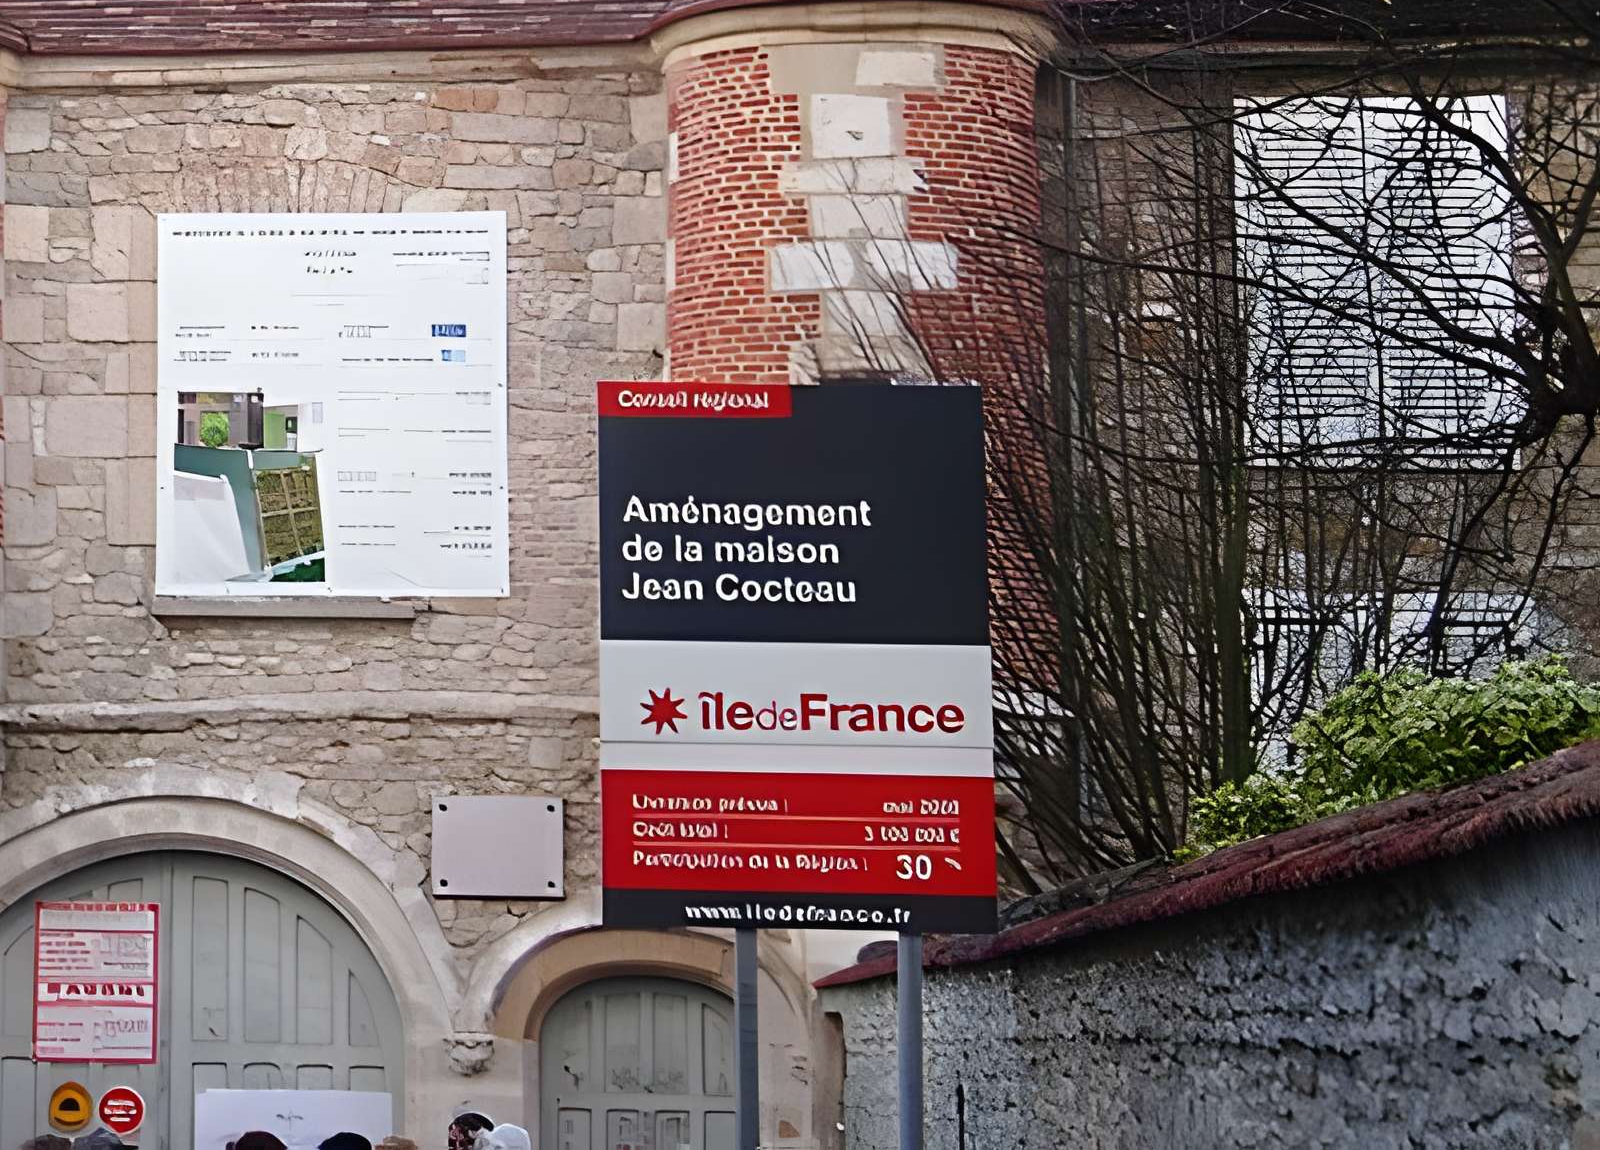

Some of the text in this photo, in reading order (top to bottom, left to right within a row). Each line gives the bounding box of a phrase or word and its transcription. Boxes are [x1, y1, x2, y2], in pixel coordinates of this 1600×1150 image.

[622, 495, 872, 532] Aménagement
[621, 533, 840, 564] de la maison
[621, 572, 857, 603] Jean Cocteau
